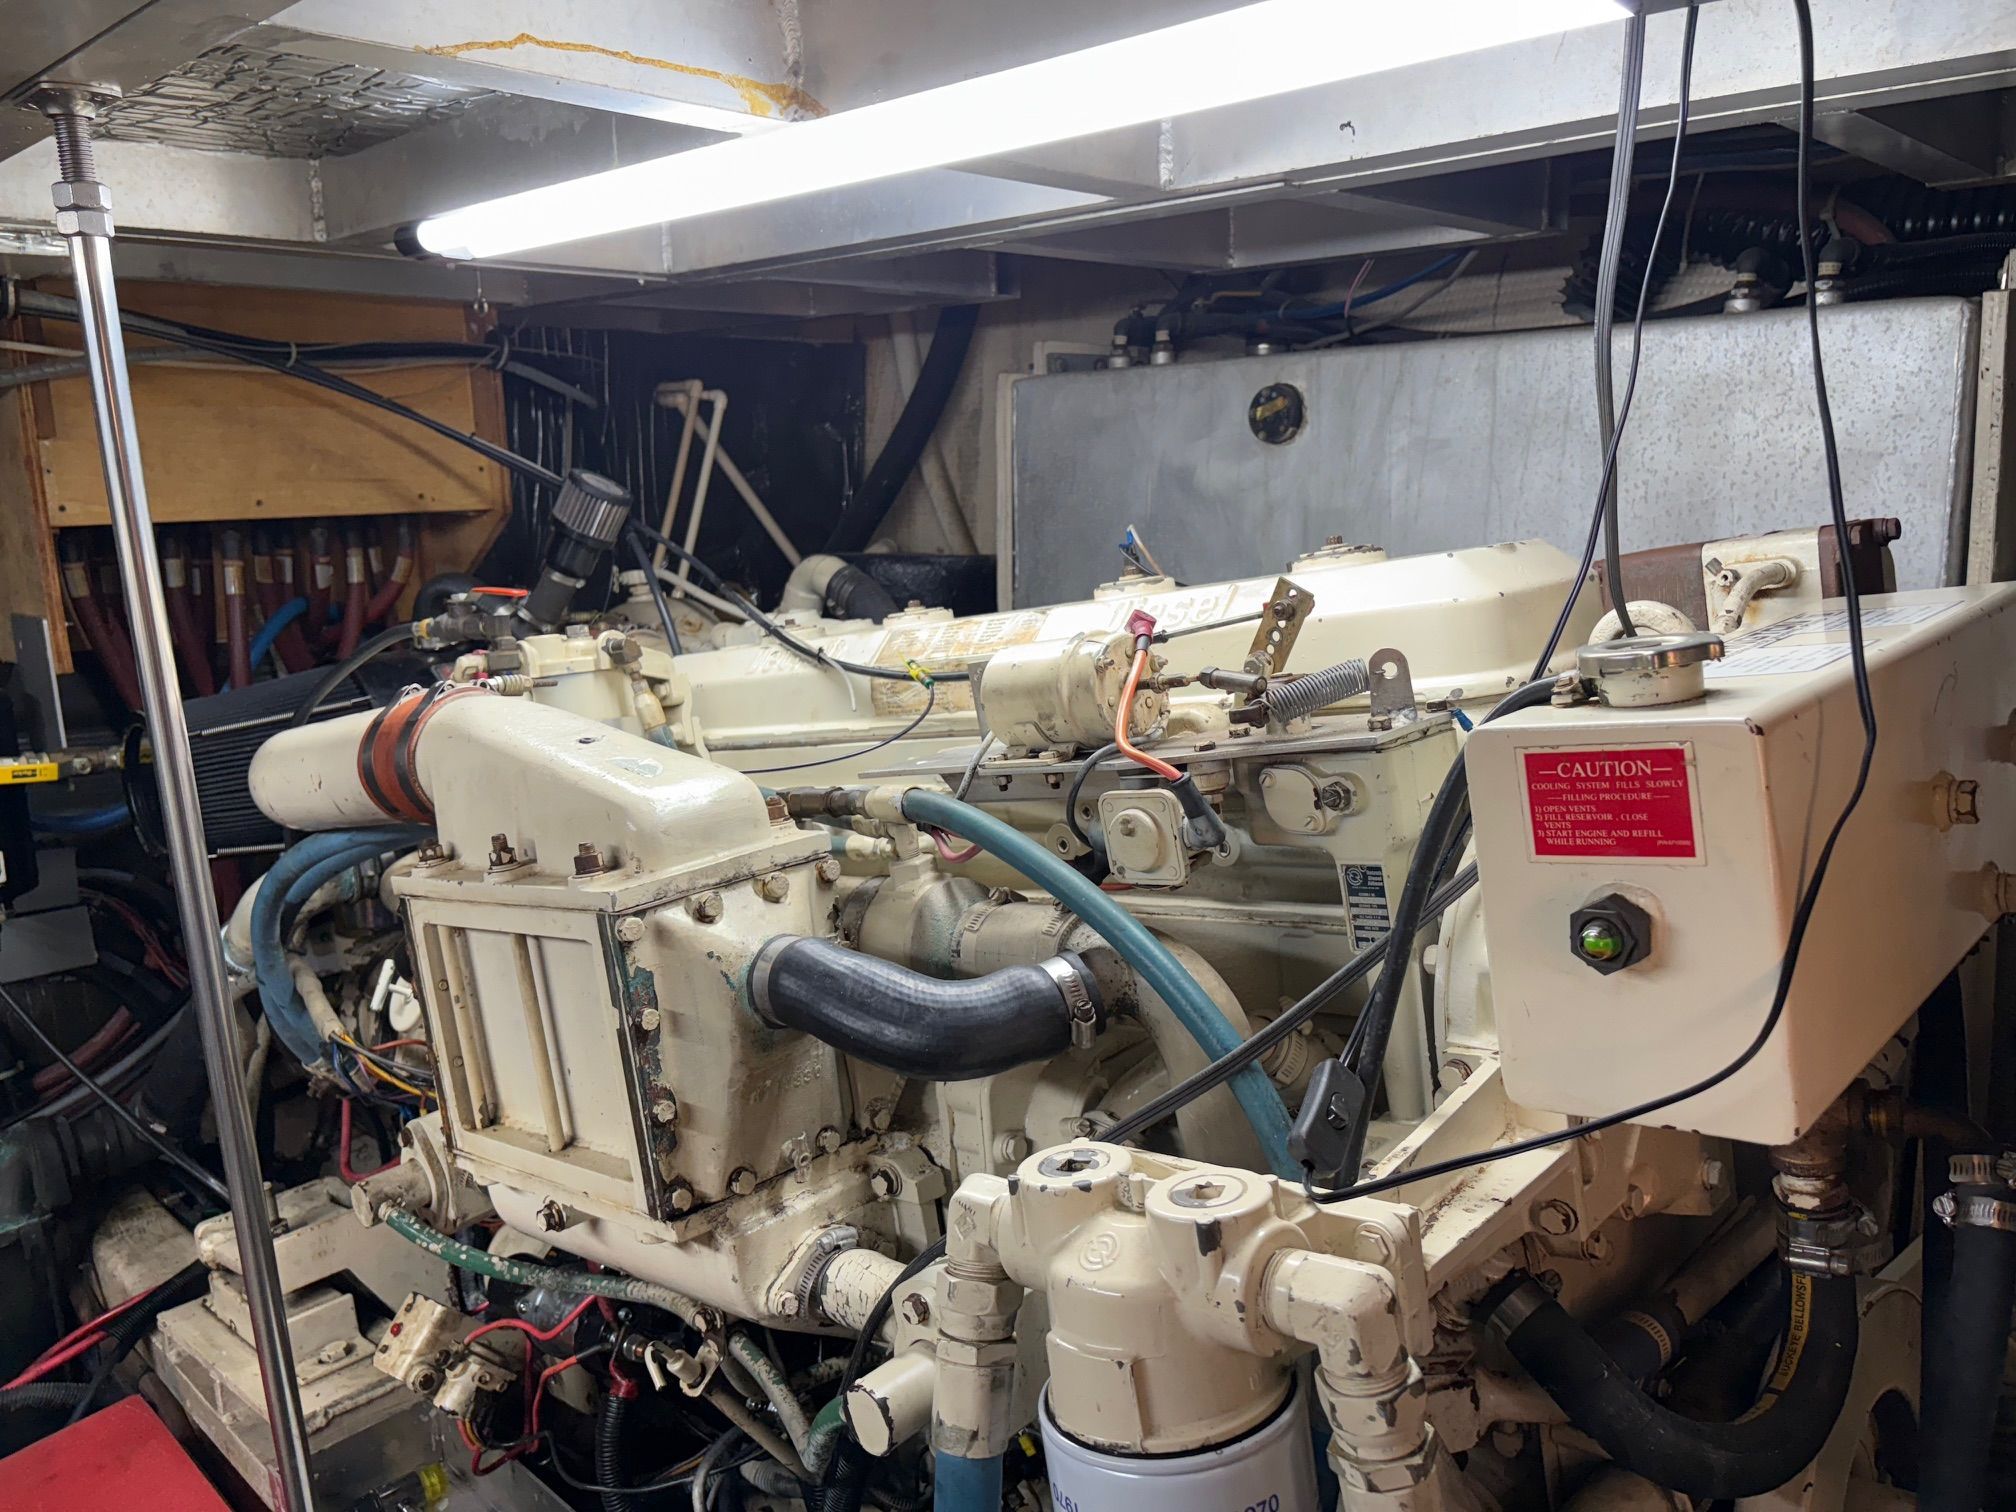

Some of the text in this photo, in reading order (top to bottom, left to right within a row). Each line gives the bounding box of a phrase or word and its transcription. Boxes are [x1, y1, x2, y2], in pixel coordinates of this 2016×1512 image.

[1557, 760, 1652, 778] CAUTION
[1646, 780, 1683, 788] SLOWLY
[1562, 793, 1597, 801] FILLING
